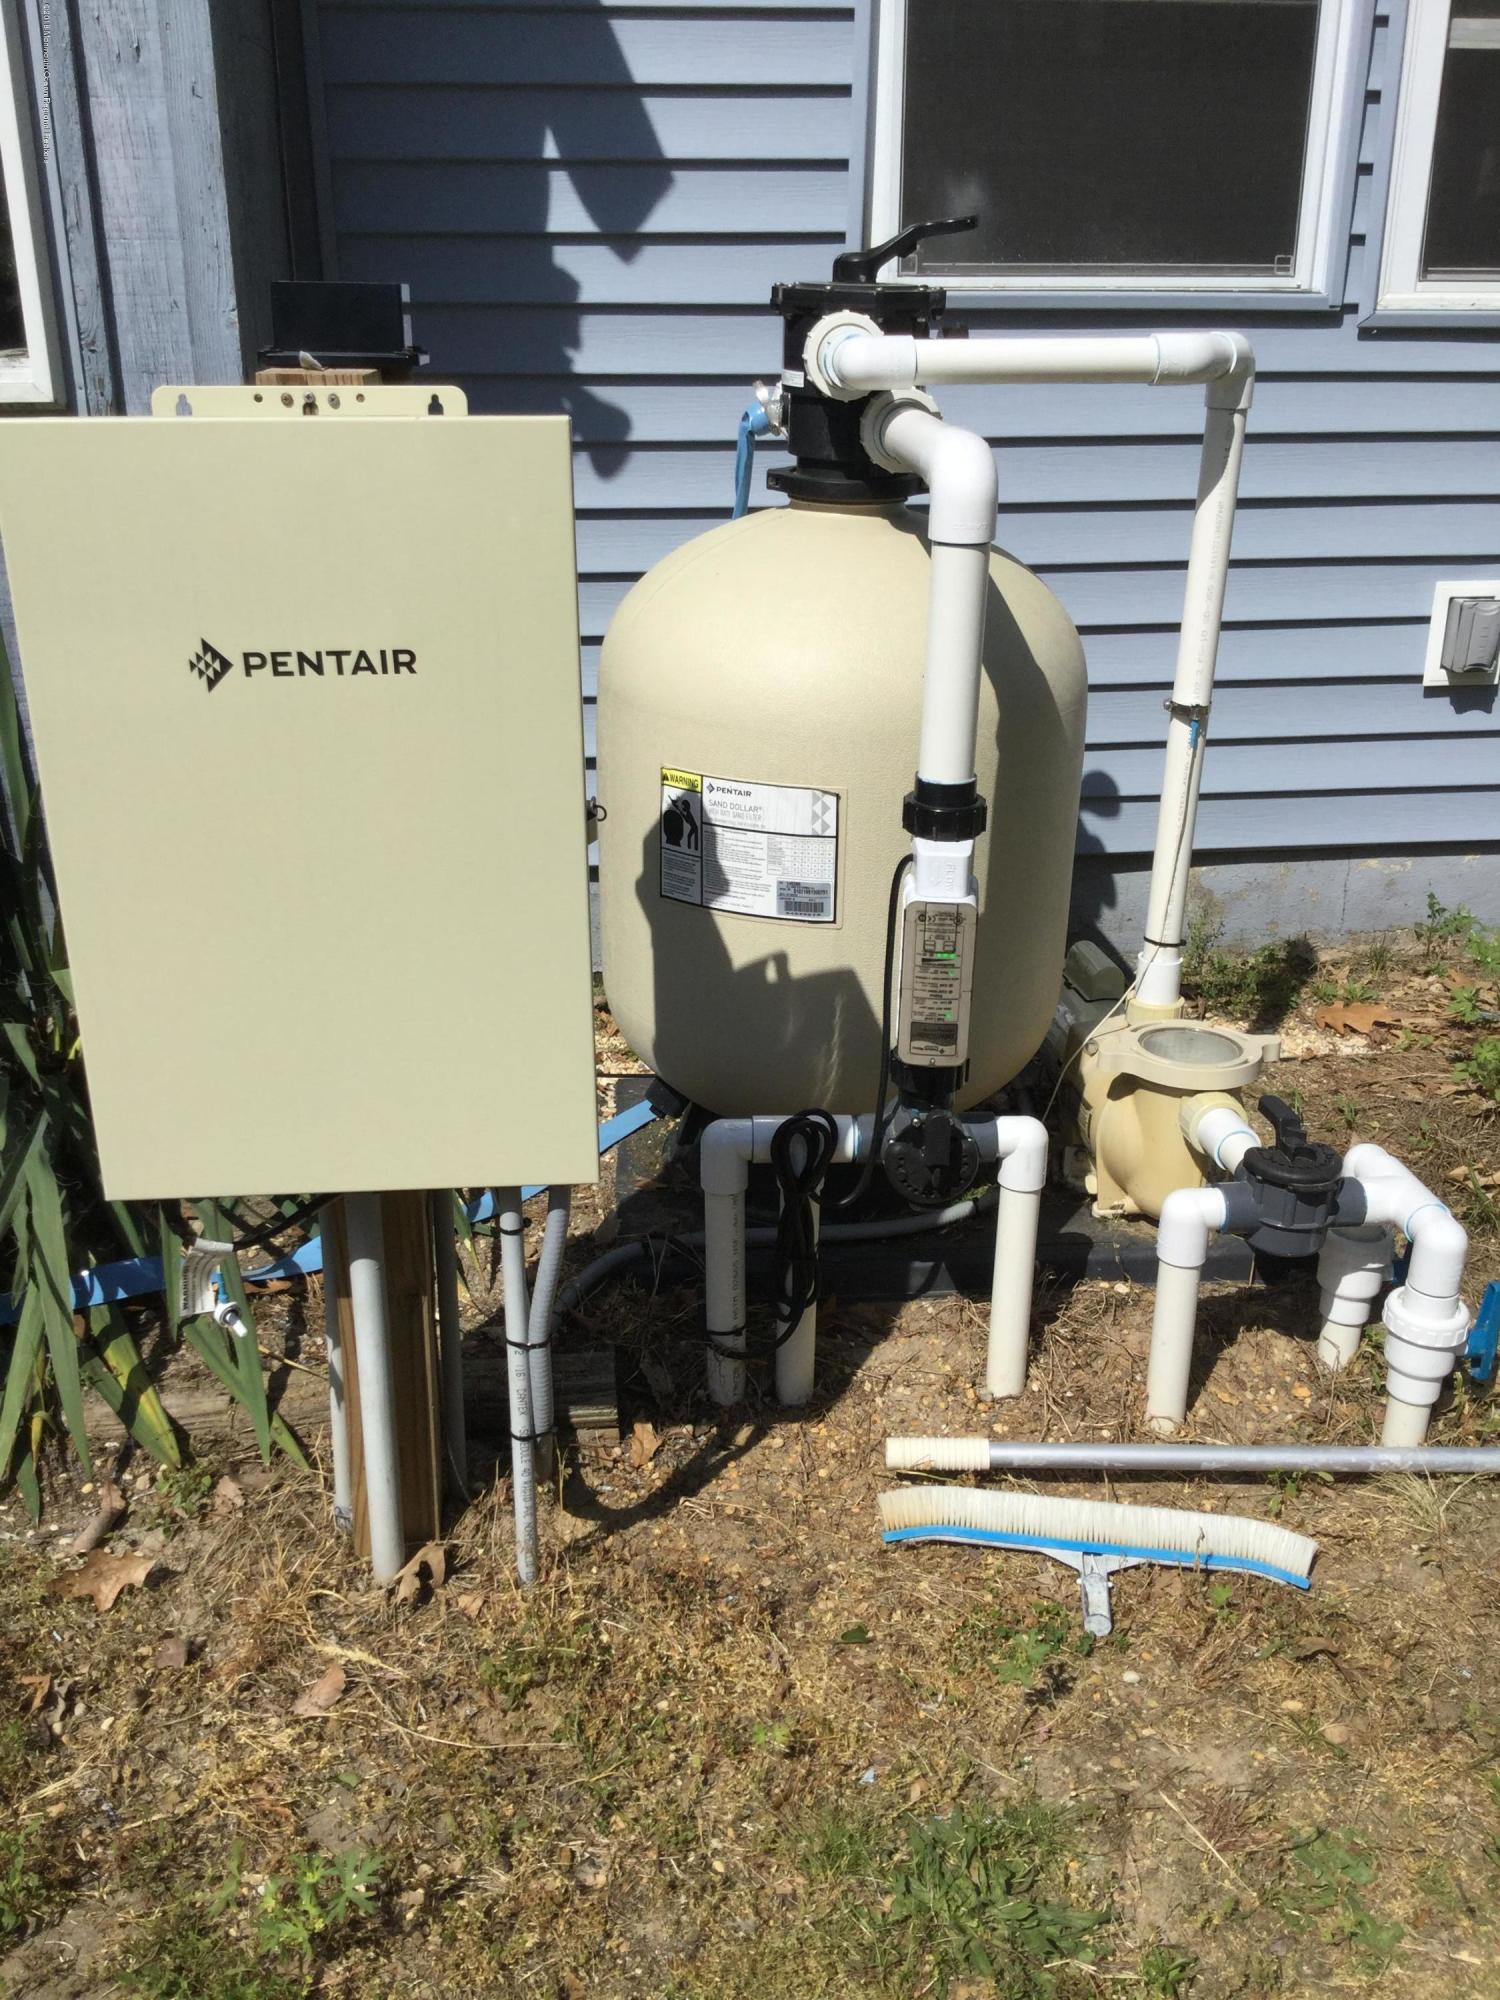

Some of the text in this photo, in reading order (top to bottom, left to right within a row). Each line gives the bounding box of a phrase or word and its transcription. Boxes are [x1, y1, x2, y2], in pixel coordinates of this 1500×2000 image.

[242, 649, 417, 677] PENTAIR
[669, 773, 699, 789] WARNING
[716, 786, 752, 797] PENTAIR
[708, 799, 728, 809] SAND
[516, 1388, 529, 1417] CANTEX
